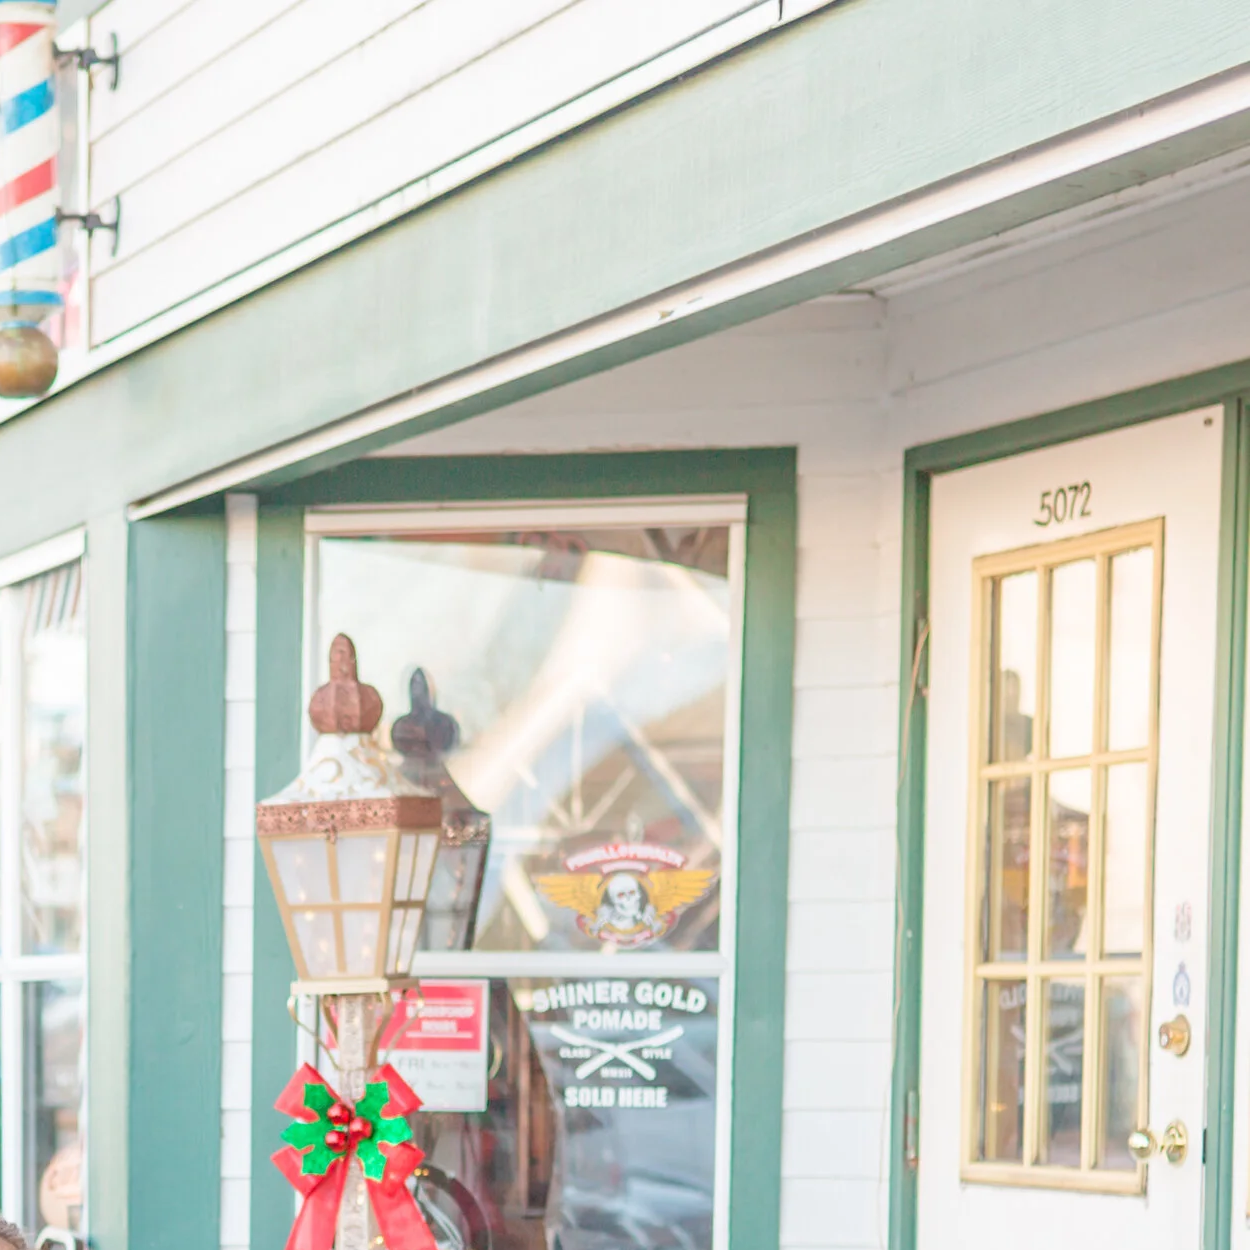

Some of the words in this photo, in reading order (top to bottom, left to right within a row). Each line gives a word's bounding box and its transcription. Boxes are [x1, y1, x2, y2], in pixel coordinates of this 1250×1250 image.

[1033, 481, 1092, 527] 5072
[532, 981, 629, 1012] SHINER
[635, 981, 707, 1013] GOLD
[573, 1010, 662, 1031] POMADE
[564, 1086, 615, 1108] SOLD
[619, 1086, 668, 1108] HERE
